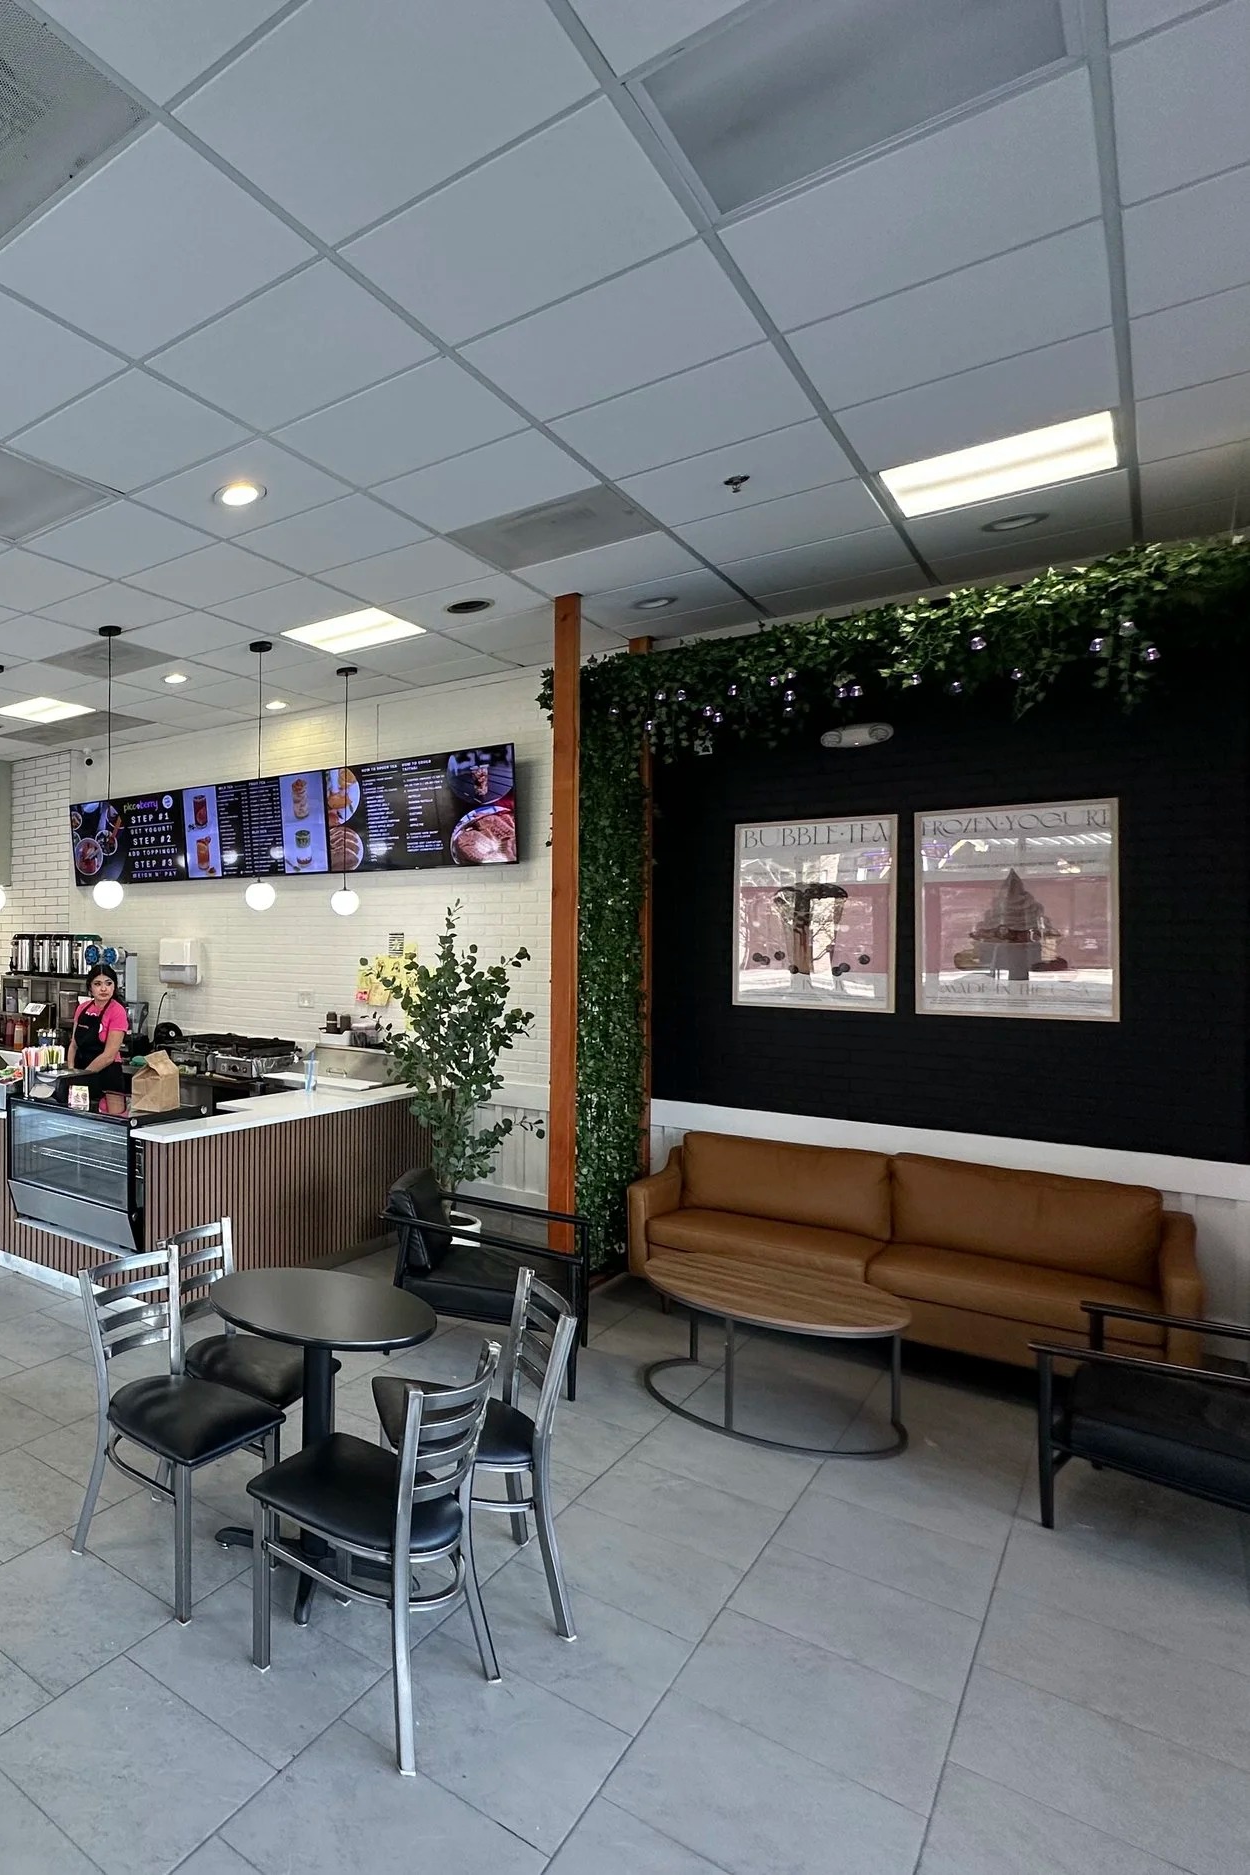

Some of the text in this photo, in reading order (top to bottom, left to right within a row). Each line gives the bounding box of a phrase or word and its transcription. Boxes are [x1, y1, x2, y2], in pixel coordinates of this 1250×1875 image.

[131, 812, 169, 824] STEP #1
[145, 825, 173, 833] YOGURT!
[133, 834, 171, 846] STEP #2
[143, 847, 178, 856] TOPPINGS!
[134, 858, 173, 869] STEP #3
